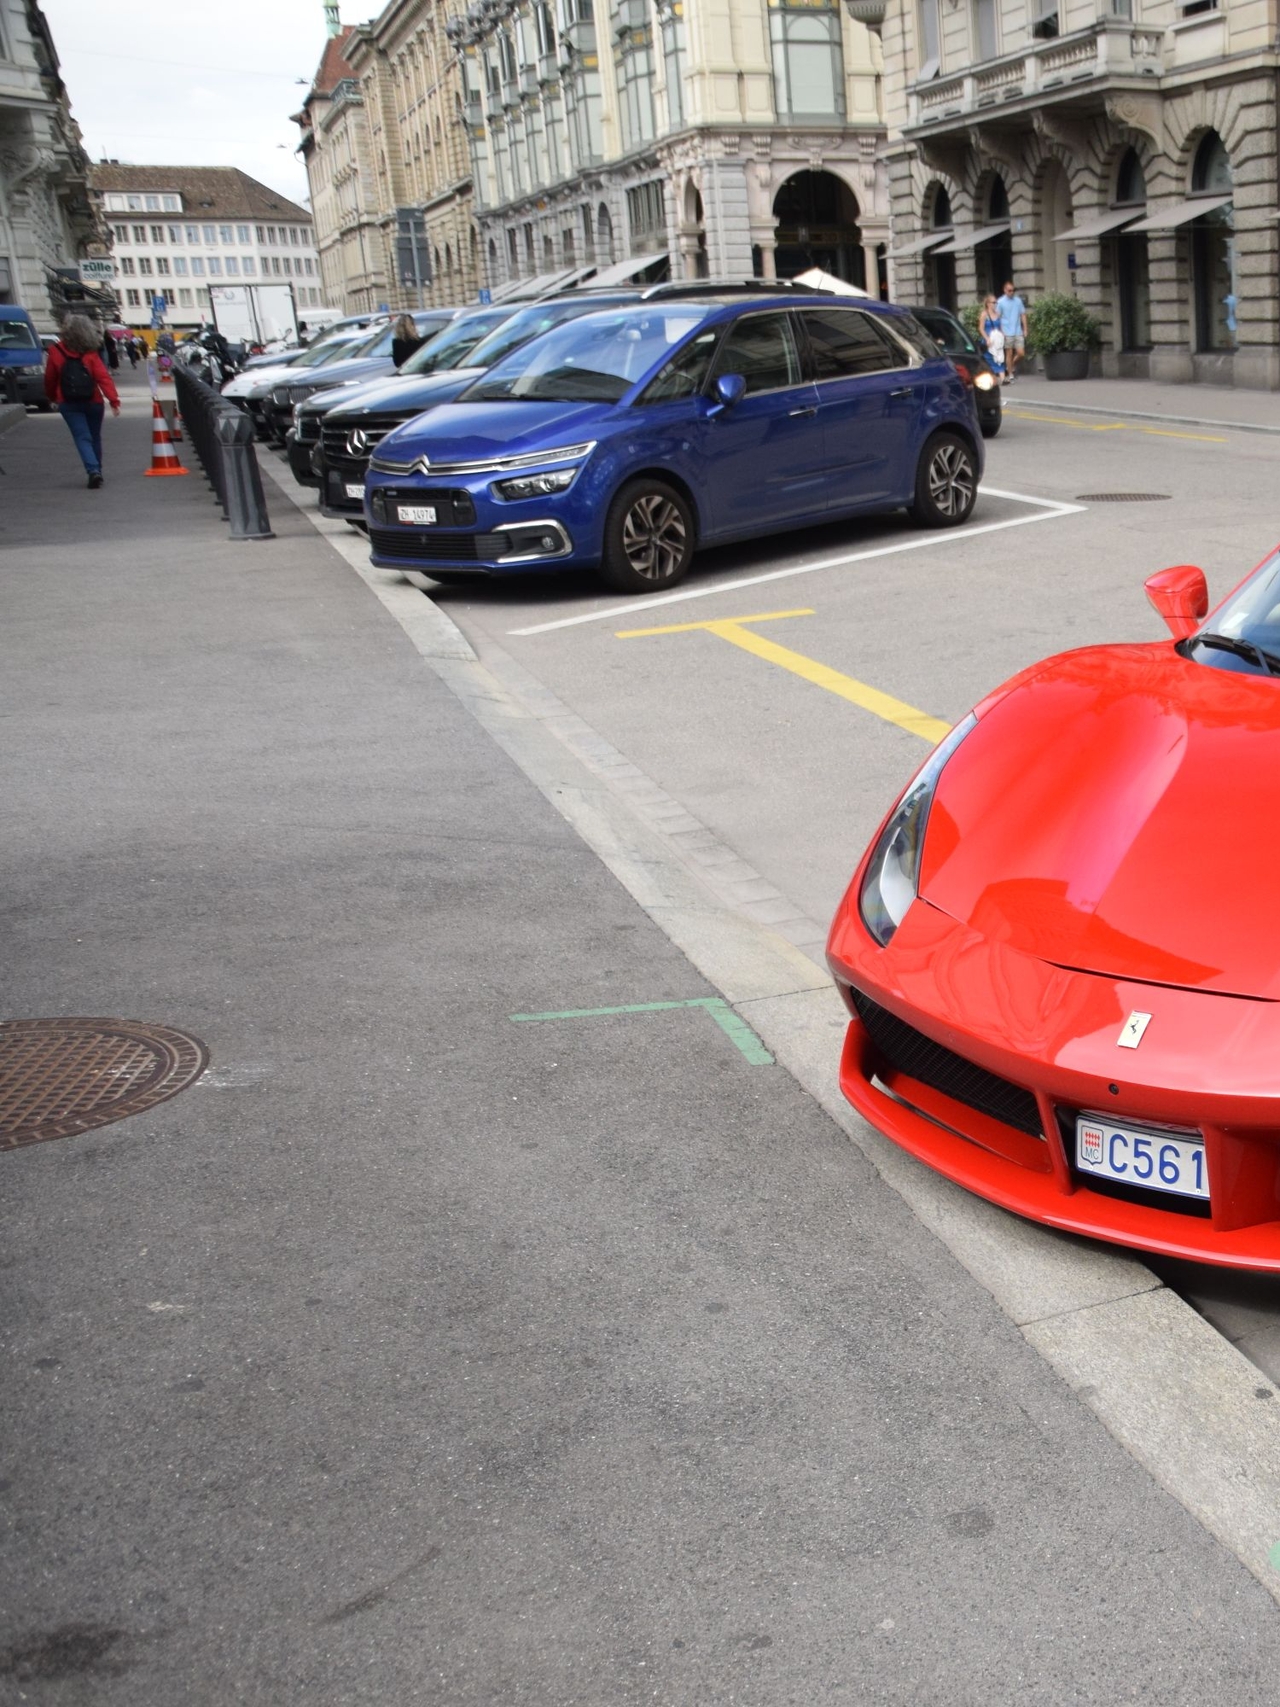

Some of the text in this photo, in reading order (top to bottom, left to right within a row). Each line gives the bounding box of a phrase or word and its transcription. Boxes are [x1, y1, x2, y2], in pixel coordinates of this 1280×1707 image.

[82, 261, 112, 272] zülle
[1084, 1148, 1100, 1161] MC
[1108, 1133, 1204, 1190] C561
